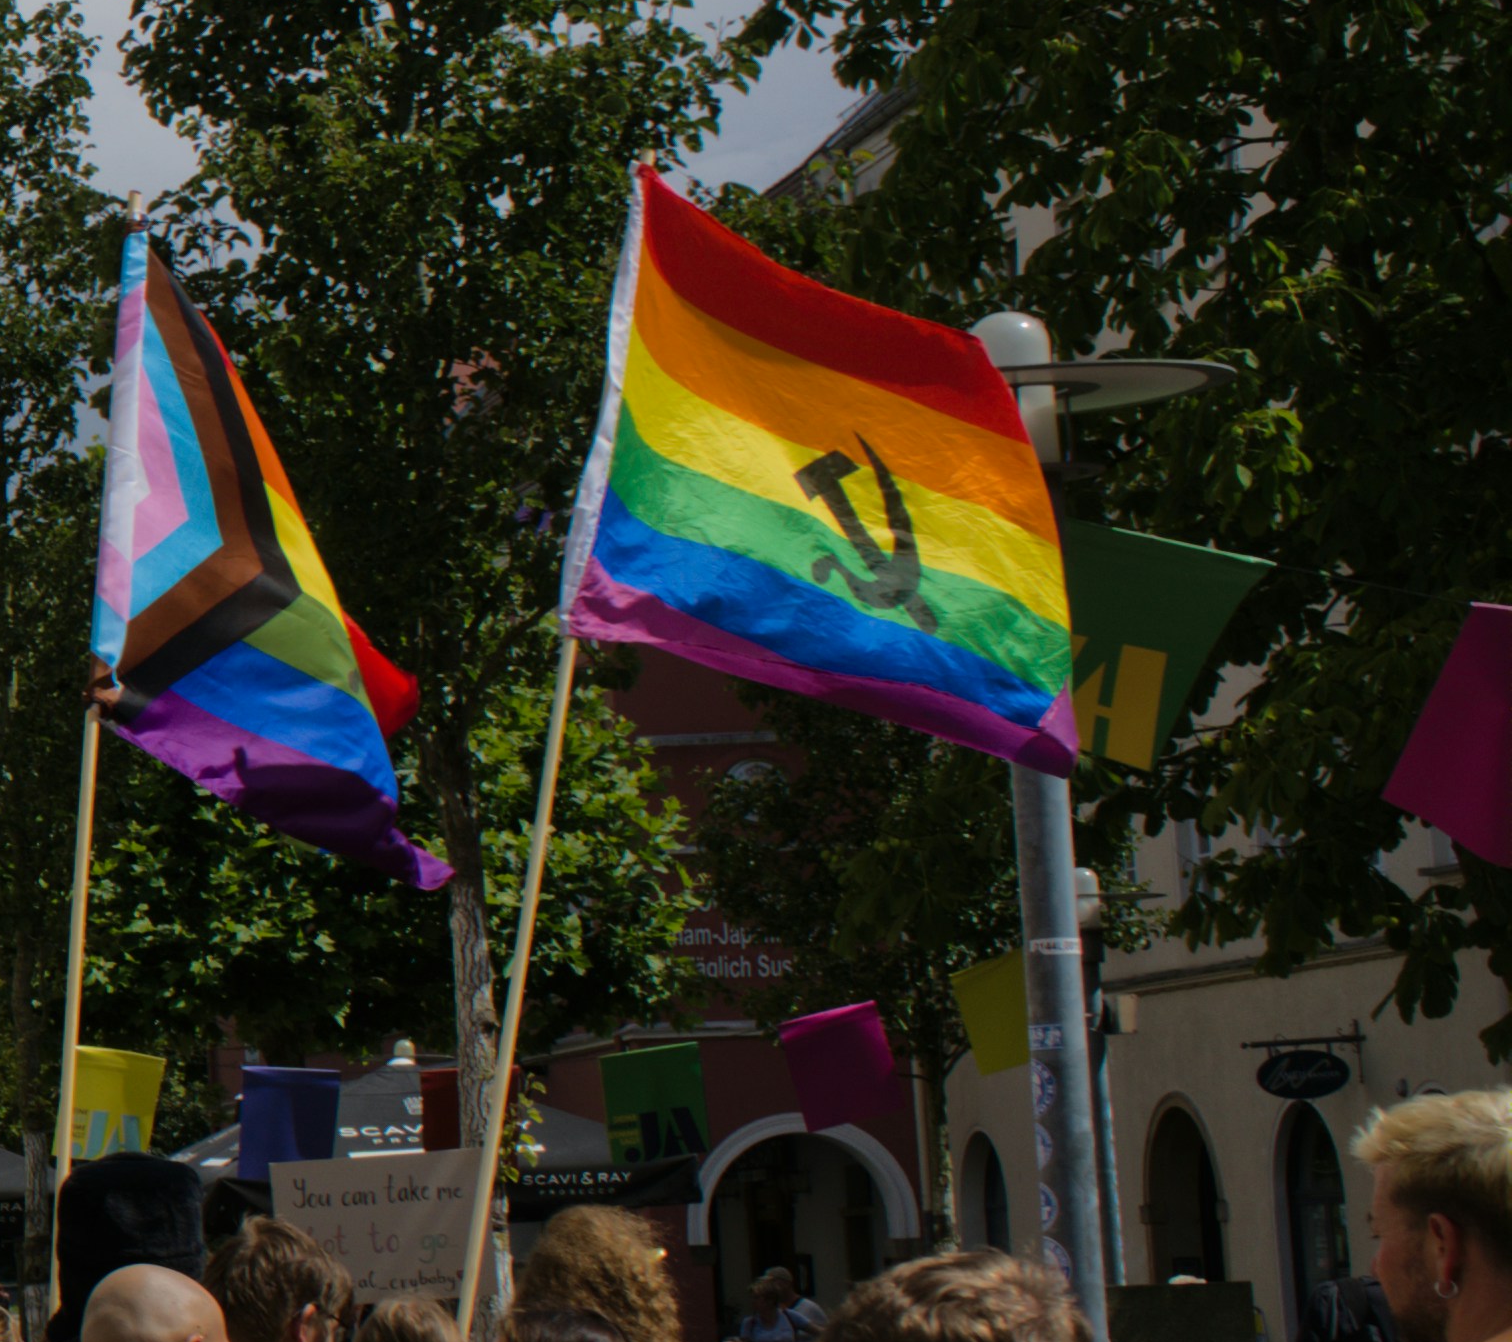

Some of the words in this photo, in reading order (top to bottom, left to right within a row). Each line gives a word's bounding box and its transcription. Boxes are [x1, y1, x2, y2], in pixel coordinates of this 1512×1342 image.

[292, 1177, 332, 1209] You
[340, 1188, 377, 1207] can
[383, 1174, 430, 1204] take
[435, 1185, 464, 1201] me
[369, 1221, 402, 1255] to
